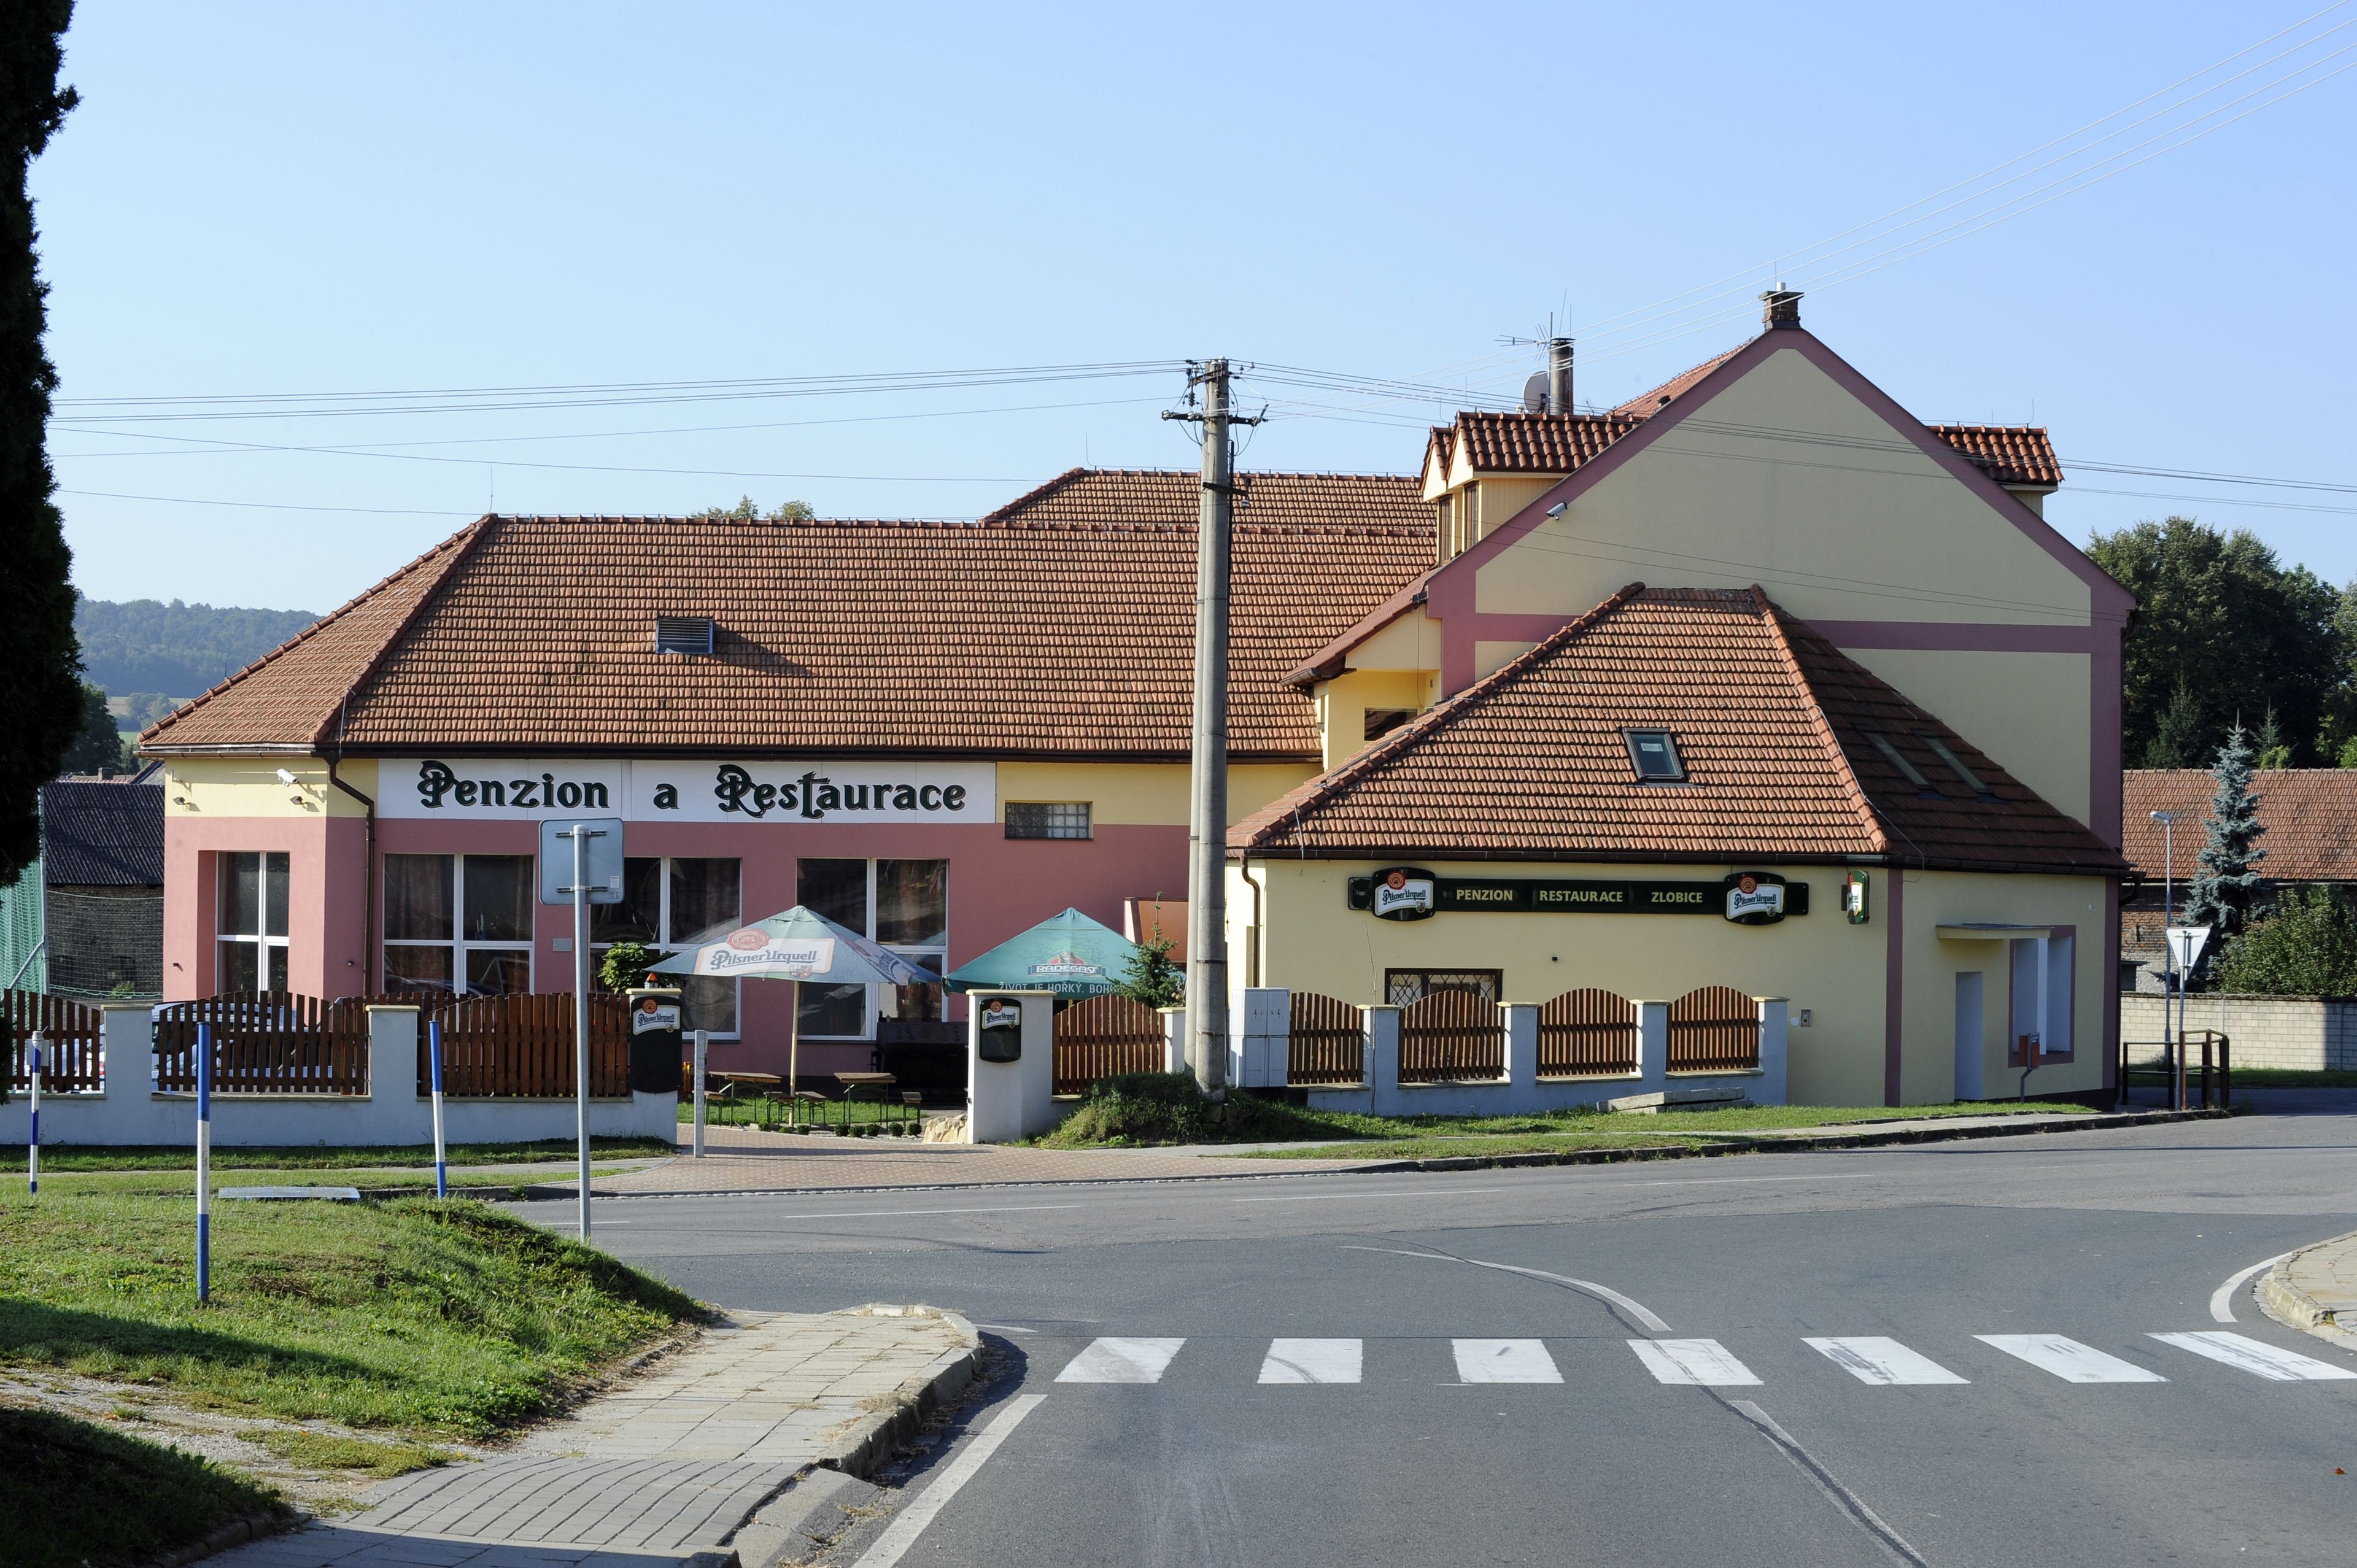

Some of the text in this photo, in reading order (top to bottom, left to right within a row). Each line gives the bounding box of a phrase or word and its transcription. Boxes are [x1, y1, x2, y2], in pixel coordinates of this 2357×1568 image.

[417, 760, 966, 819] Penzion a Restaurace
[1383, 889, 1426, 905] Pilsner Urquell
[1457, 889, 1703, 903] PENZION RESTAURACE ZLOBICE
[1734, 894, 1776, 910] Pilsner Urquell
[710, 950, 818, 971] Pilsner Urquell
[1036, 965, 1098, 974] RADEGAST
[1048, 982, 1084, 993] HOŘKÝ.
